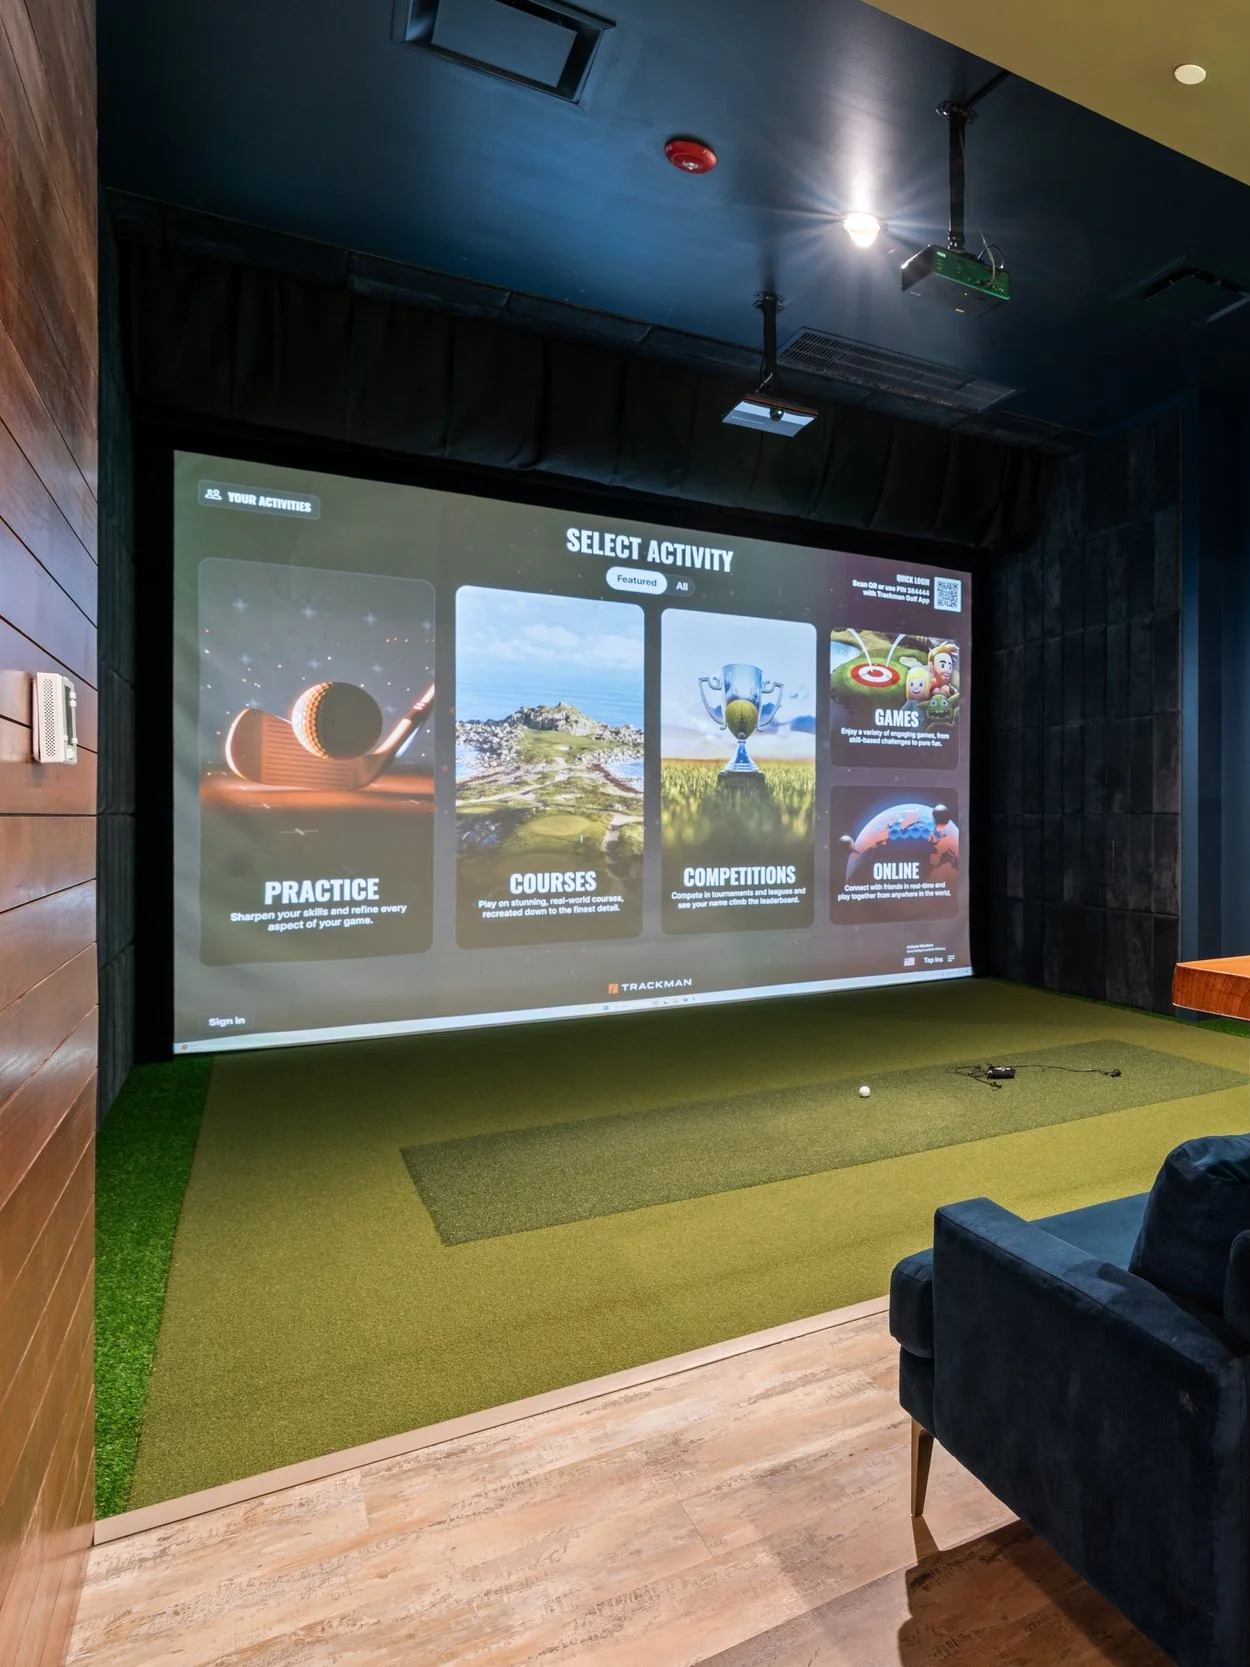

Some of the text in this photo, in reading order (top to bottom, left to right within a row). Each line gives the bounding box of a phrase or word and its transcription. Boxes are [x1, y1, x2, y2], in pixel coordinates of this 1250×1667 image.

[227, 492, 312, 512] YOUR ACTIVITIES
[566, 528, 734, 572] SELECT ACTIVITY
[617, 574, 688, 591] Featured All
[896, 574, 914, 584] QUICK
[852, 580, 867, 588] Scan
[885, 584, 896, 592] use
[896, 586, 906, 594] PIN
[877, 590, 905, 601] Trackman
[906, 595, 917, 603] Golf
[918, 597, 930, 605] App
[875, 709, 919, 728] GAMES
[841, 728, 857, 736] Enjoy
[864, 729, 882, 737] variety
[890, 731, 916, 739] engaging
[917, 732, 936, 740] games,
[849, 736, 880, 744] skill-based
[881, 738, 911, 746] challenges
[683, 865, 796, 887] COMPETITIONS
[873, 862, 920, 880] ONLINE
[510, 870, 596, 894] COURSES
[844, 884, 869, 892] Connect
[264, 878, 379, 904] PRACTICE
[671, 891, 703, 900] Compete
[704, 890, 710, 898] in
[712, 889, 754, 898] tournaments
[768, 888, 793, 897] leagues
[851, 892, 876, 900] together
[891, 891, 918, 899] anywhere
[478, 900, 496, 910] Play
[511, 898, 549, 908] stunning,
[550, 896, 590, 905] real-world
[692, 901, 708, 910] your
[729, 898, 747, 906] climb
[760, 896, 800, 904] leaderboard.
[230, 904, 407, 923] Sharpen your skills and refine every
[482, 908, 522, 918] recreated
[524, 908, 547, 916] down
[558, 906, 572, 914] the
[573, 905, 596, 913] finest
[597, 904, 620, 912] detail.
[268, 917, 373, 932] aspect of your game.
[621, 978, 692, 991] TRACKMAN
[208, 1017, 233, 1027] Sign
